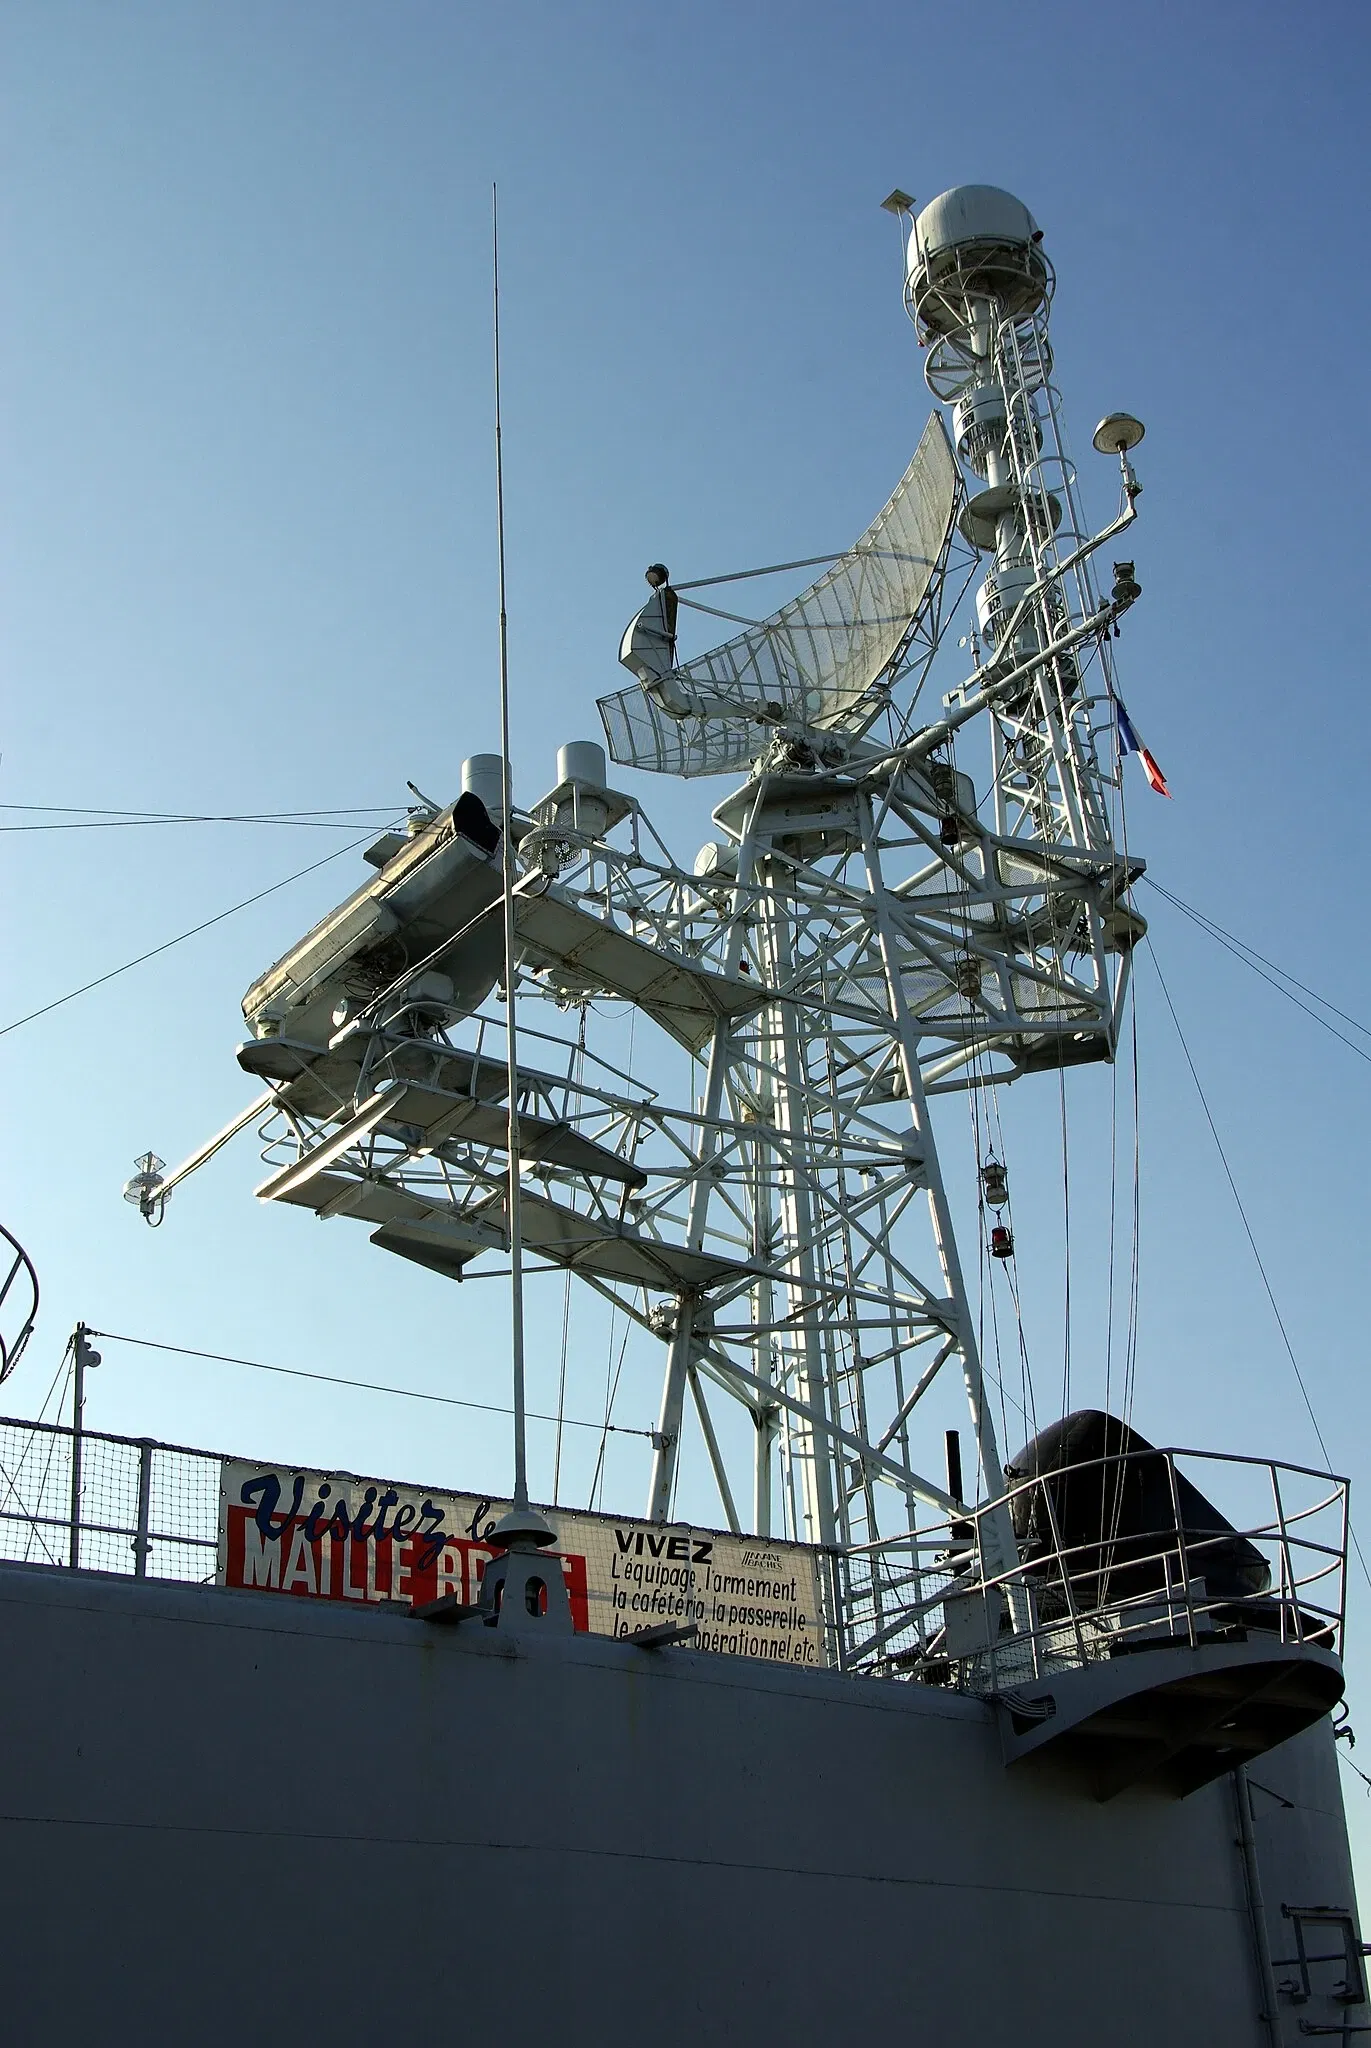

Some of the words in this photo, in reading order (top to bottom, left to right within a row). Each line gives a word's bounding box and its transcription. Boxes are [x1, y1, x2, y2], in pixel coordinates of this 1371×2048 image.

[241, 1473, 454, 1570] Visitez
[243, 1516, 415, 1602] MAILLE
[614, 1529, 713, 1565] VIVEZ
[612, 1583, 627, 1609] la
[712, 1596, 726, 1622] la
[728, 1603, 806, 1632] passerelle
[705, 1566, 797, 1602] l'armement
